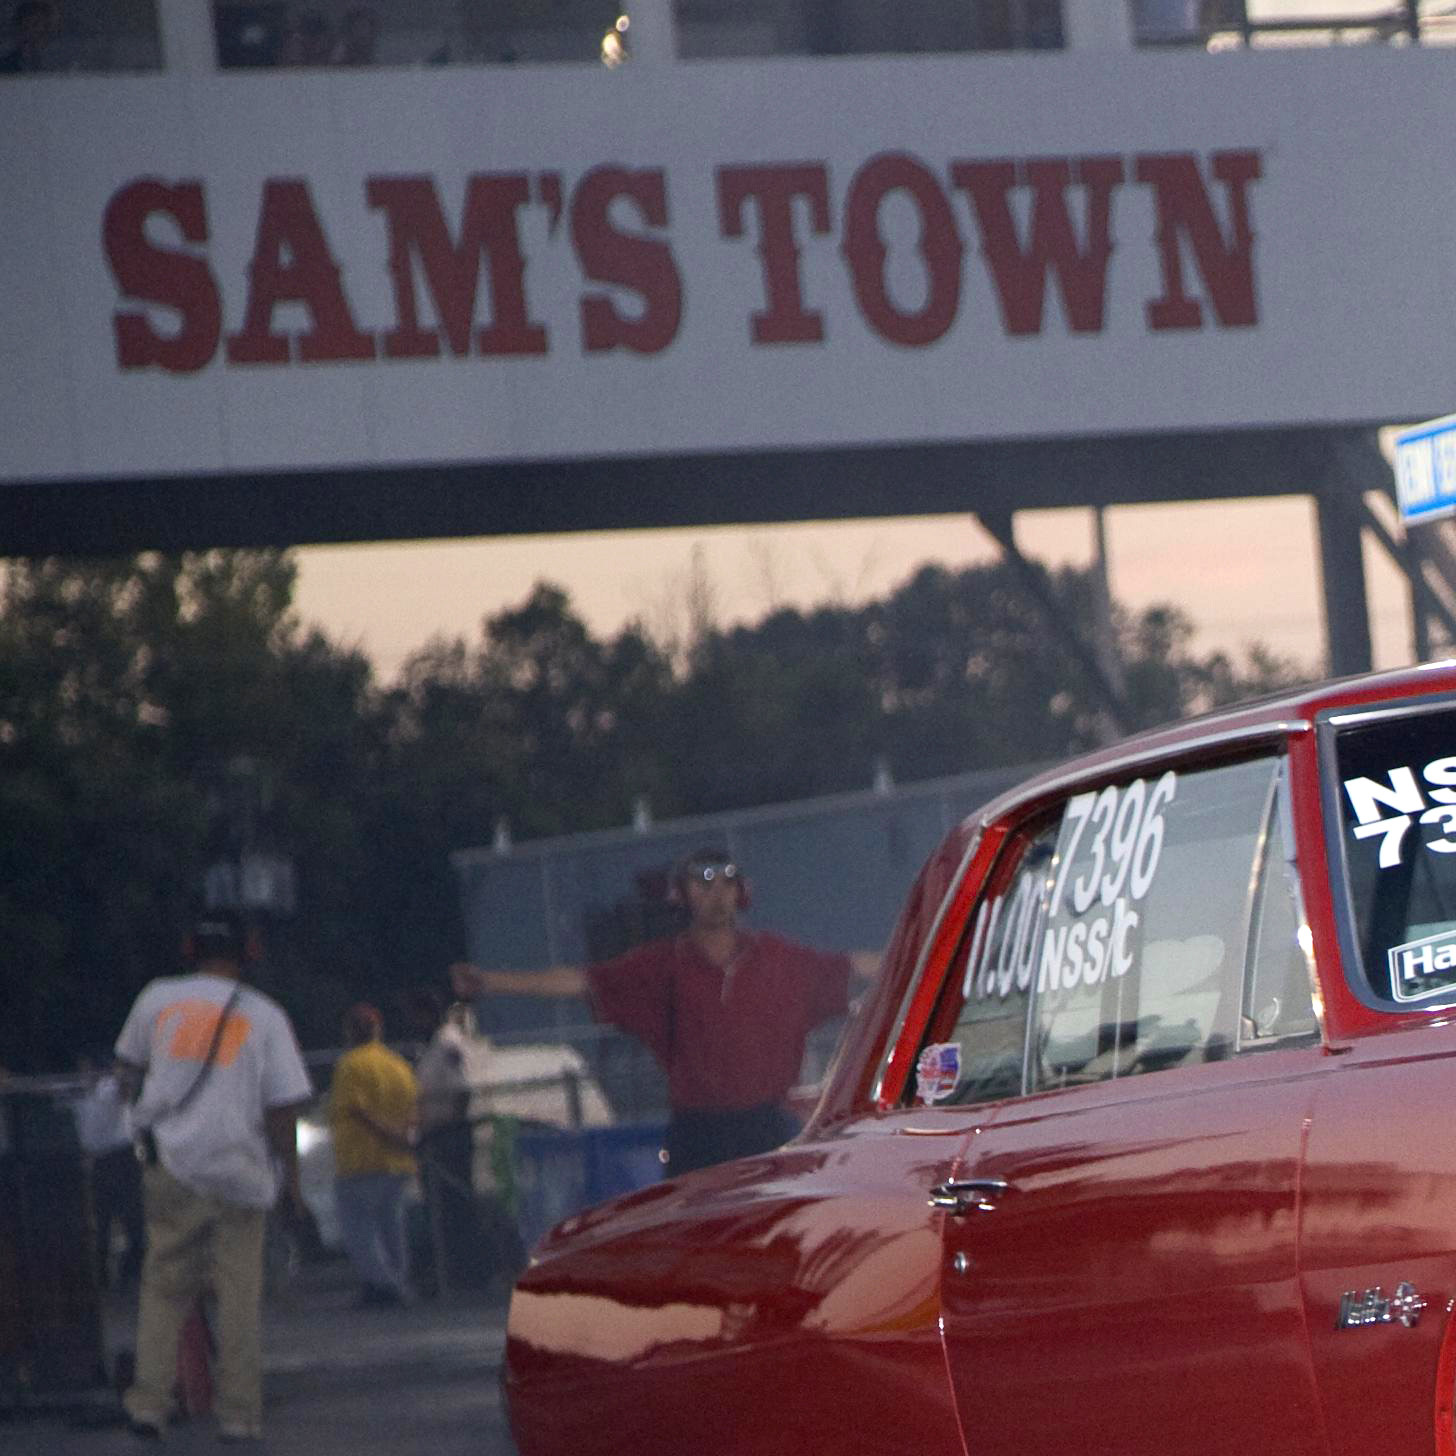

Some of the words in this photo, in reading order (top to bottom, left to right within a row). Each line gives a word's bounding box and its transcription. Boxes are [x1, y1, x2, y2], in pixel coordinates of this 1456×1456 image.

[102, 163, 684, 376] SAM'S
[715, 148, 1265, 348] TOWN
[1049, 770, 1178, 917] 7396
